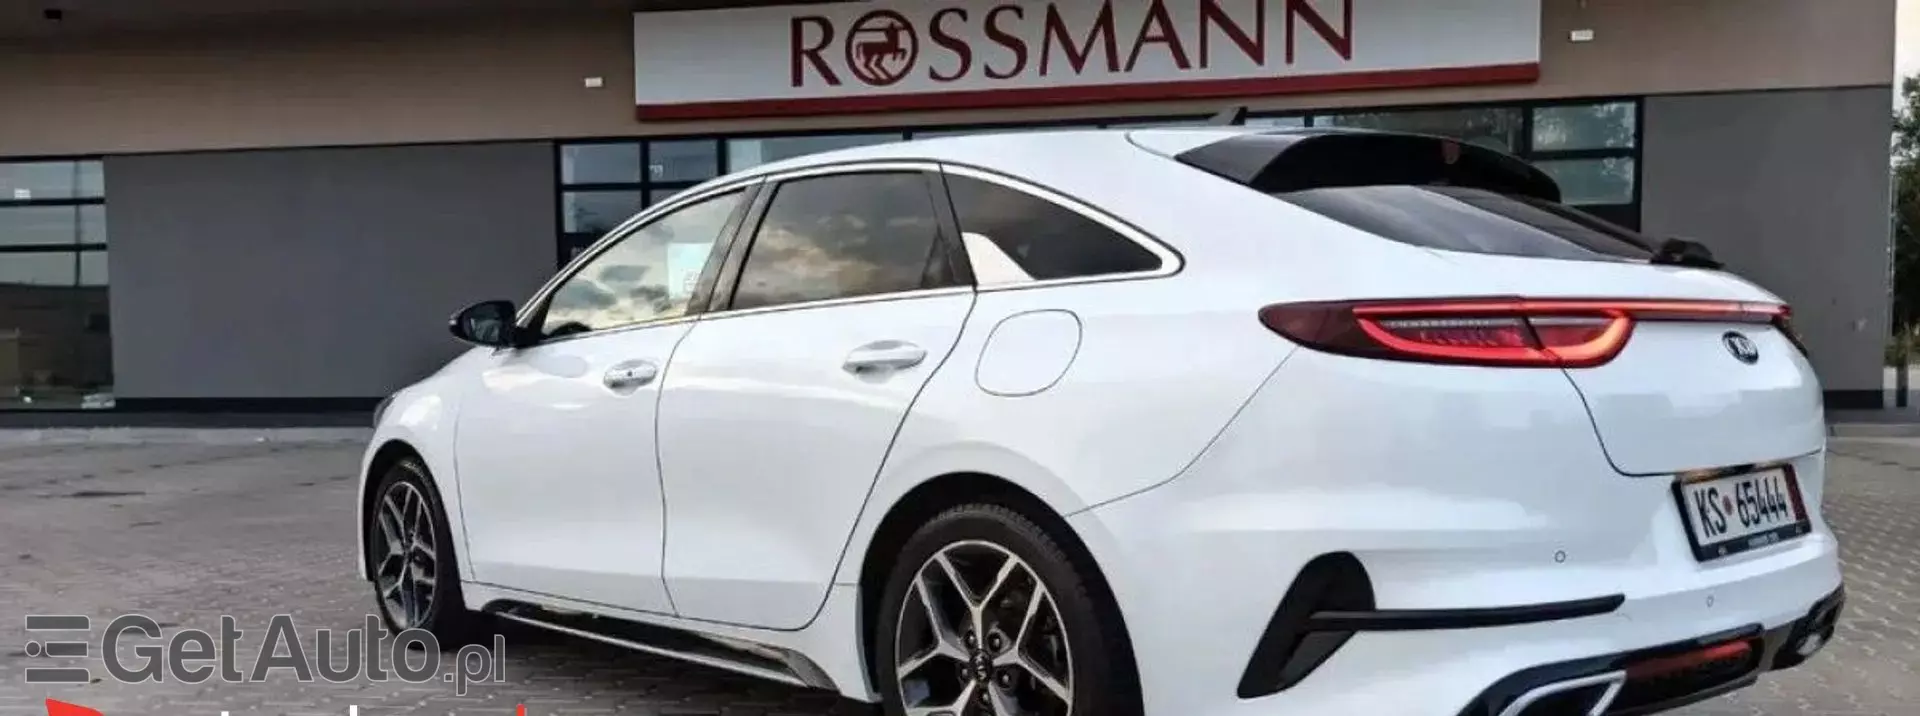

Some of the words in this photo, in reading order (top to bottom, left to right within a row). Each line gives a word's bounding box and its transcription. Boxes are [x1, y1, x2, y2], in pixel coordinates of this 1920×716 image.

[790, 0, 1352, 87] ROSSMANN
[1694, 486, 1727, 538] KS
[1735, 475, 1788, 529] 65444
